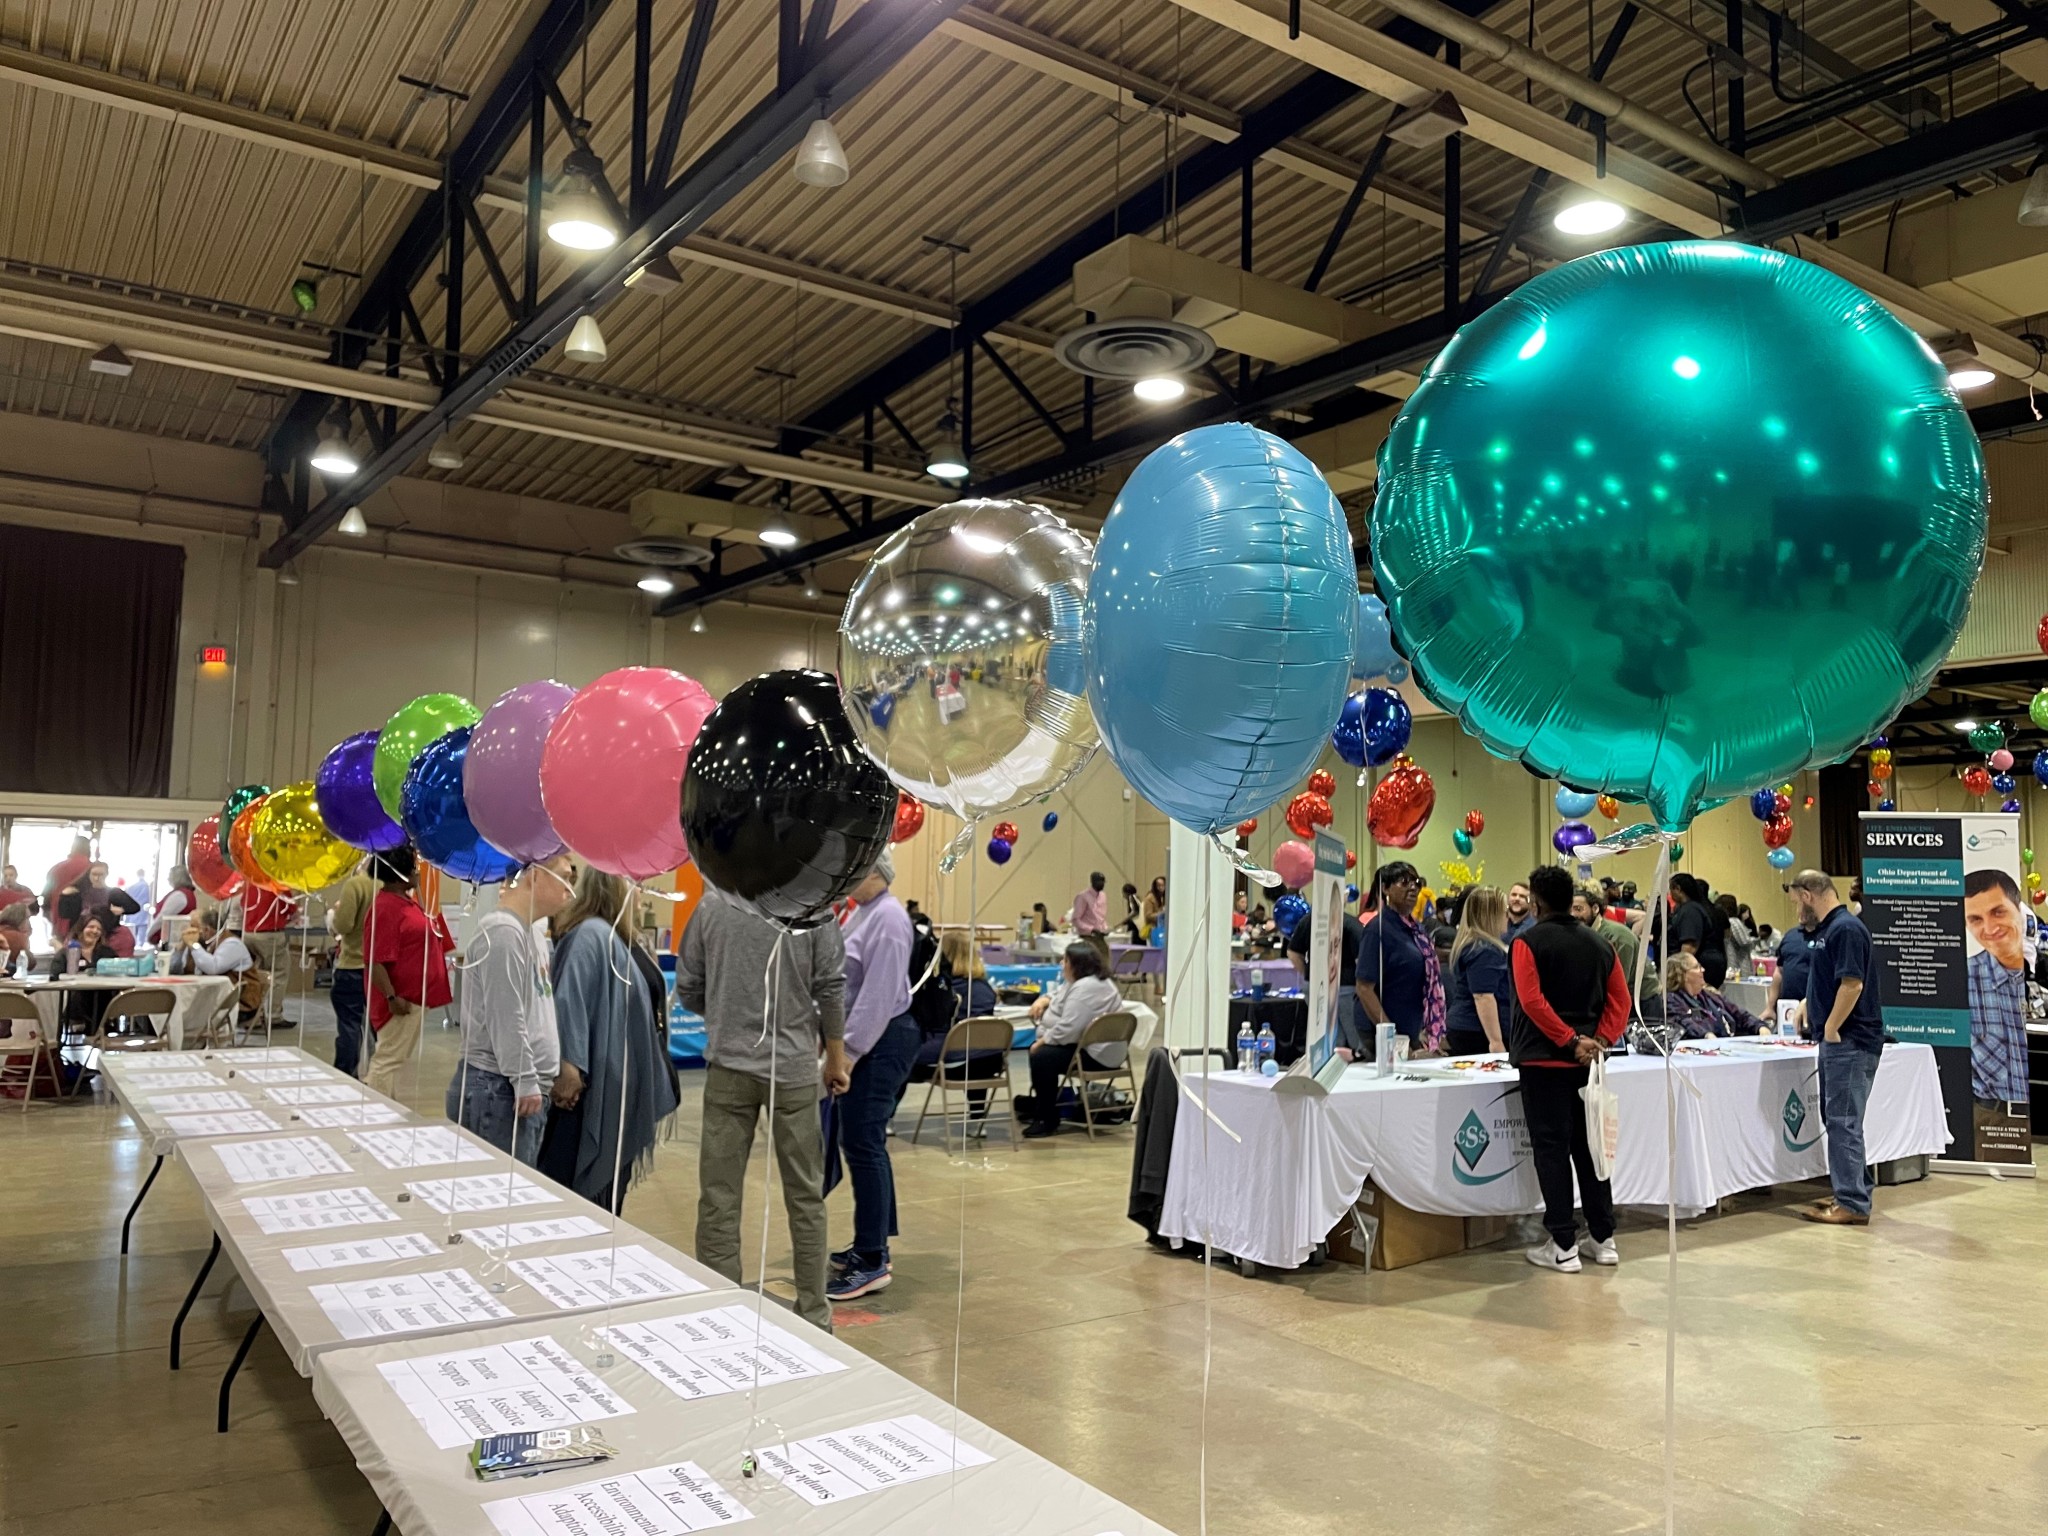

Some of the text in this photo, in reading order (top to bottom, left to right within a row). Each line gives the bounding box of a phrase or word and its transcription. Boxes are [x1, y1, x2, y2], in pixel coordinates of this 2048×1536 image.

[205, 649, 227, 661] EXIT
[1866, 833, 1944, 846] SERVICES
[1866, 877, 1917, 885] Developmental
[1897, 869, 1938, 877] Department
[1886, 1024, 1955, 1034] Specialized Services
[1494, 1130, 1516, 1139] WITH
[675, 1323, 708, 1342] Remote
[697, 1317, 735, 1339] Supports
[468, 1358, 498, 1380] Remote
[522, 1356, 538, 1365] For
[710, 1358, 757, 1382] Adaptive
[734, 1352, 778, 1375] Assistive
[754, 1345, 807, 1374] Equipment
[438, 1361, 470, 1386] Supports
[690, 1370, 708, 1379] For
[516, 1391, 554, 1418] Adaptive
[563, 1394, 580, 1403] For
[570, 1377, 618, 1414] Sample Balloon
[454, 1399, 498, 1435] Equipment
[488, 1398, 525, 1426] Assistive
[848, 1436, 916, 1472] Accessibility
[878, 1433, 934, 1462] Adaptions
[808, 1464, 830, 1475] For
[817, 1438, 896, 1483] Environmental
[762, 1451, 834, 1499] Sample Balloon
[664, 1492, 685, 1504] For
[668, 1468, 732, 1520] Sample Balloon
[601, 1482, 666, 1536] Environmental
